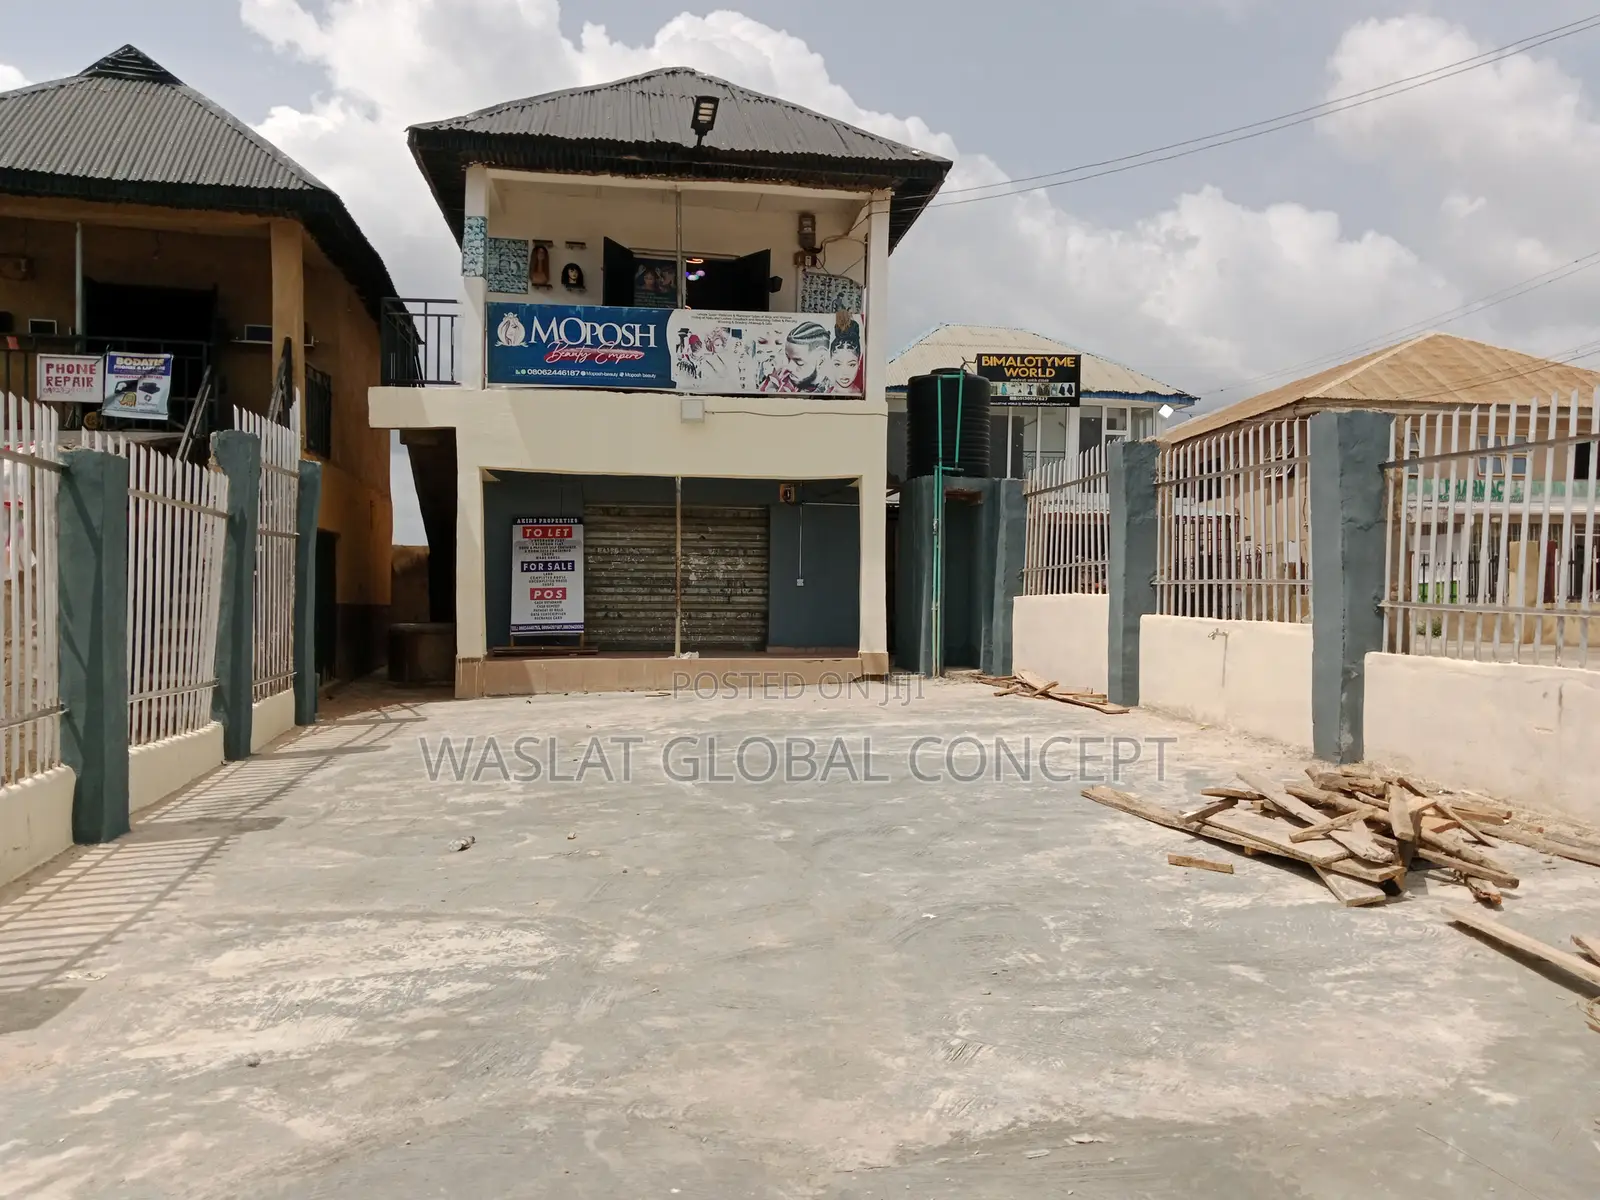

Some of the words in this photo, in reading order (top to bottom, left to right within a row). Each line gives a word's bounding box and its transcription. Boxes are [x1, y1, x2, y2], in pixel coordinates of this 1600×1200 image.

[529, 315, 657, 347] MOPOSH
[546, 339, 591, 363] Beauty
[982, 355, 1075, 367] BIMALOTYME
[45, 363, 96, 375] PHONE
[1004, 367, 1056, 377] WORLD
[46, 376, 95, 388] REPAIR
[525, 529, 543, 538] TO
[547, 528, 570, 537] LET
[523, 562, 544, 571] FOR
[547, 562, 573, 570] SALE
[533, 590, 563, 599] POS
